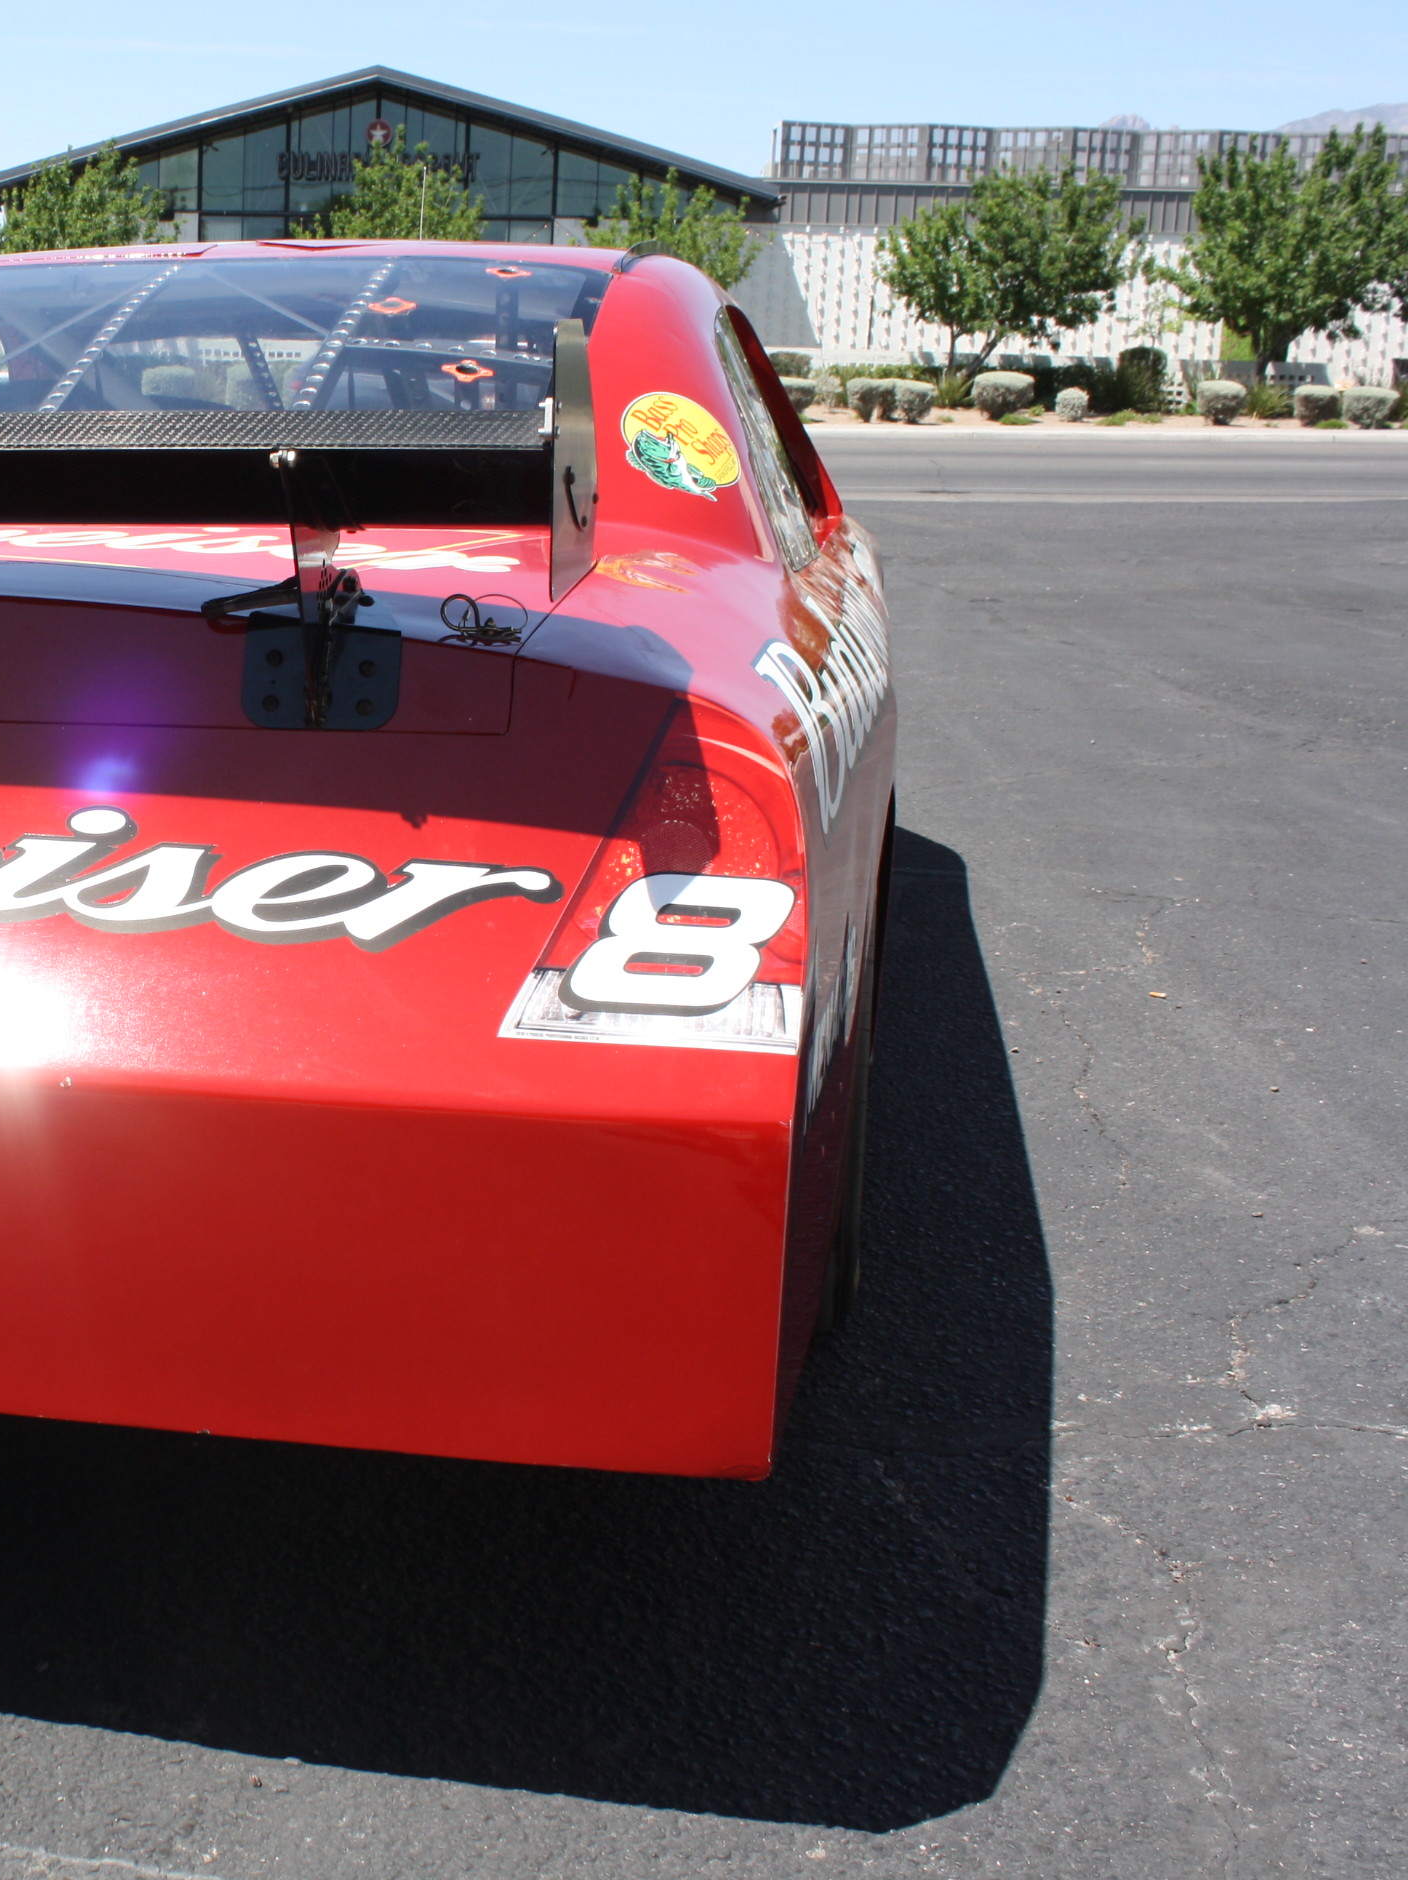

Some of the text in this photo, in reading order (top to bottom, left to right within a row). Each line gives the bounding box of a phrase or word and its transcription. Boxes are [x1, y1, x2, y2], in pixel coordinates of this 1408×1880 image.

[631, 395, 679, 433] Bass
[663, 418, 699, 447] Pro
[691, 428, 733, 466] Shops
[557, 872, 796, 1018] 8
